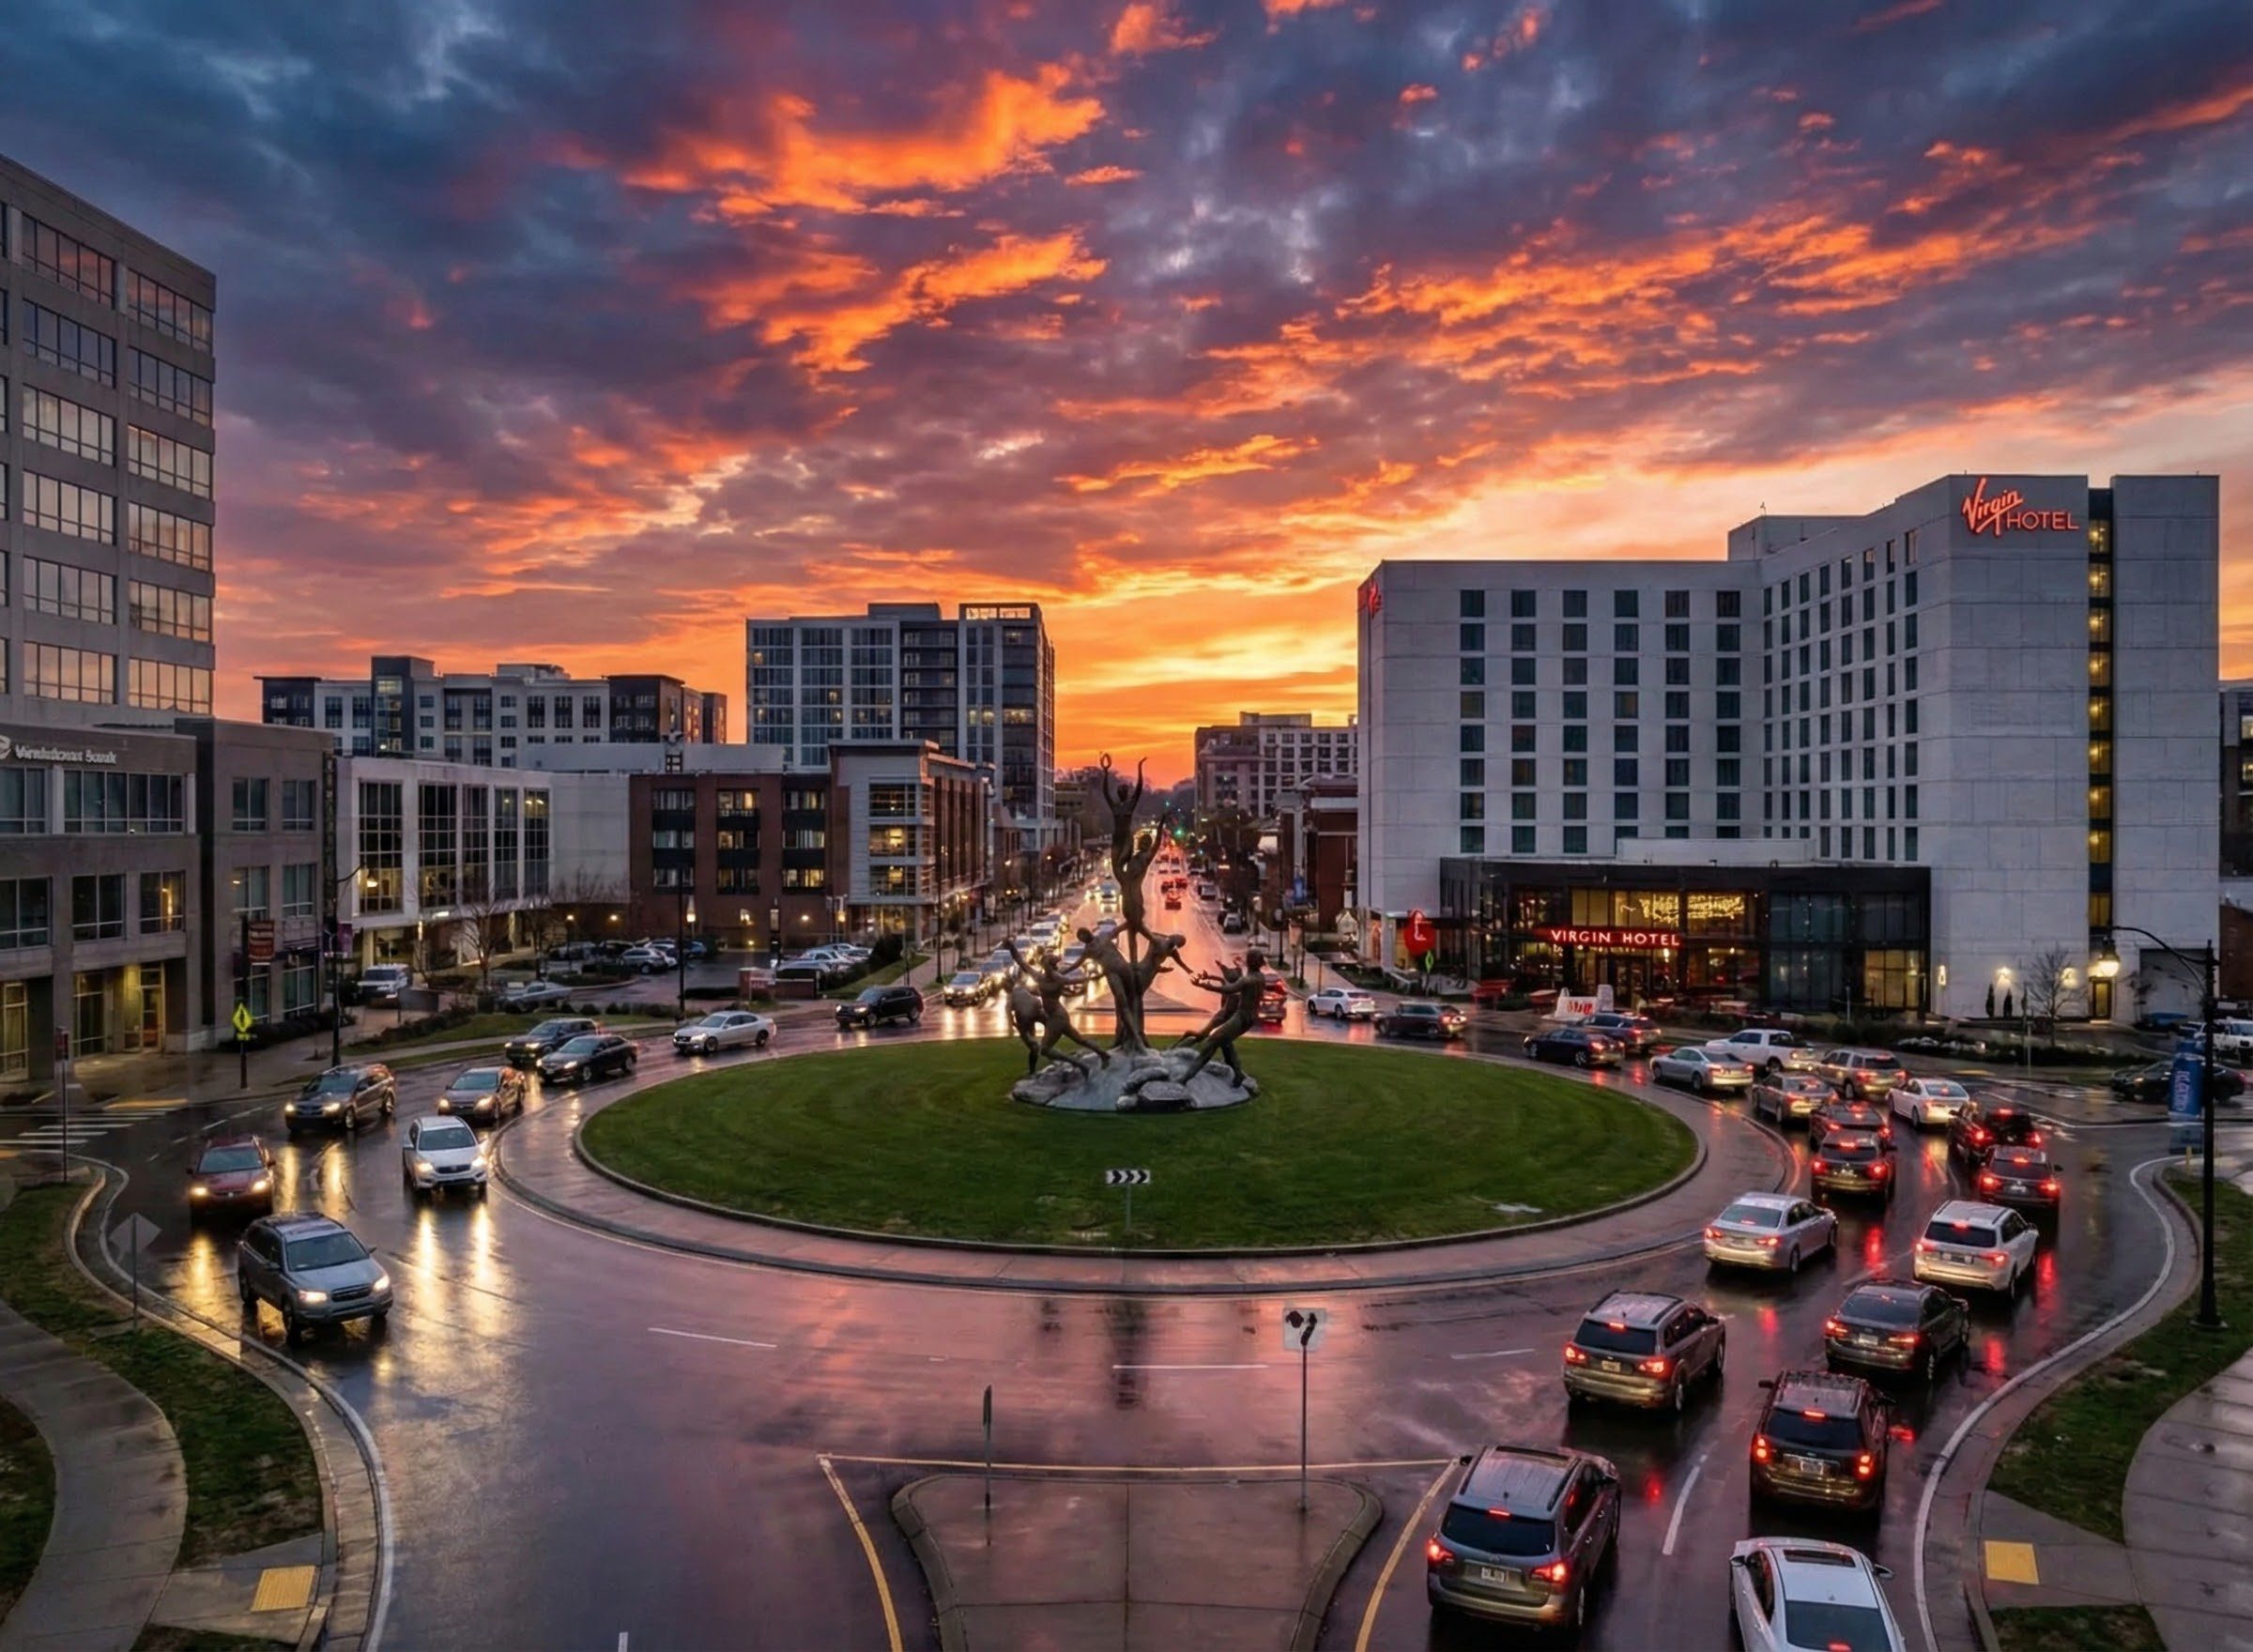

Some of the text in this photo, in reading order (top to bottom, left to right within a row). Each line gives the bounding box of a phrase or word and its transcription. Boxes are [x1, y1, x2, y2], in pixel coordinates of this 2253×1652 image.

[1962, 477, 2079, 536] Virgin HOTEL
[1551, 929, 1680, 946] VIRGIN HOTEL
